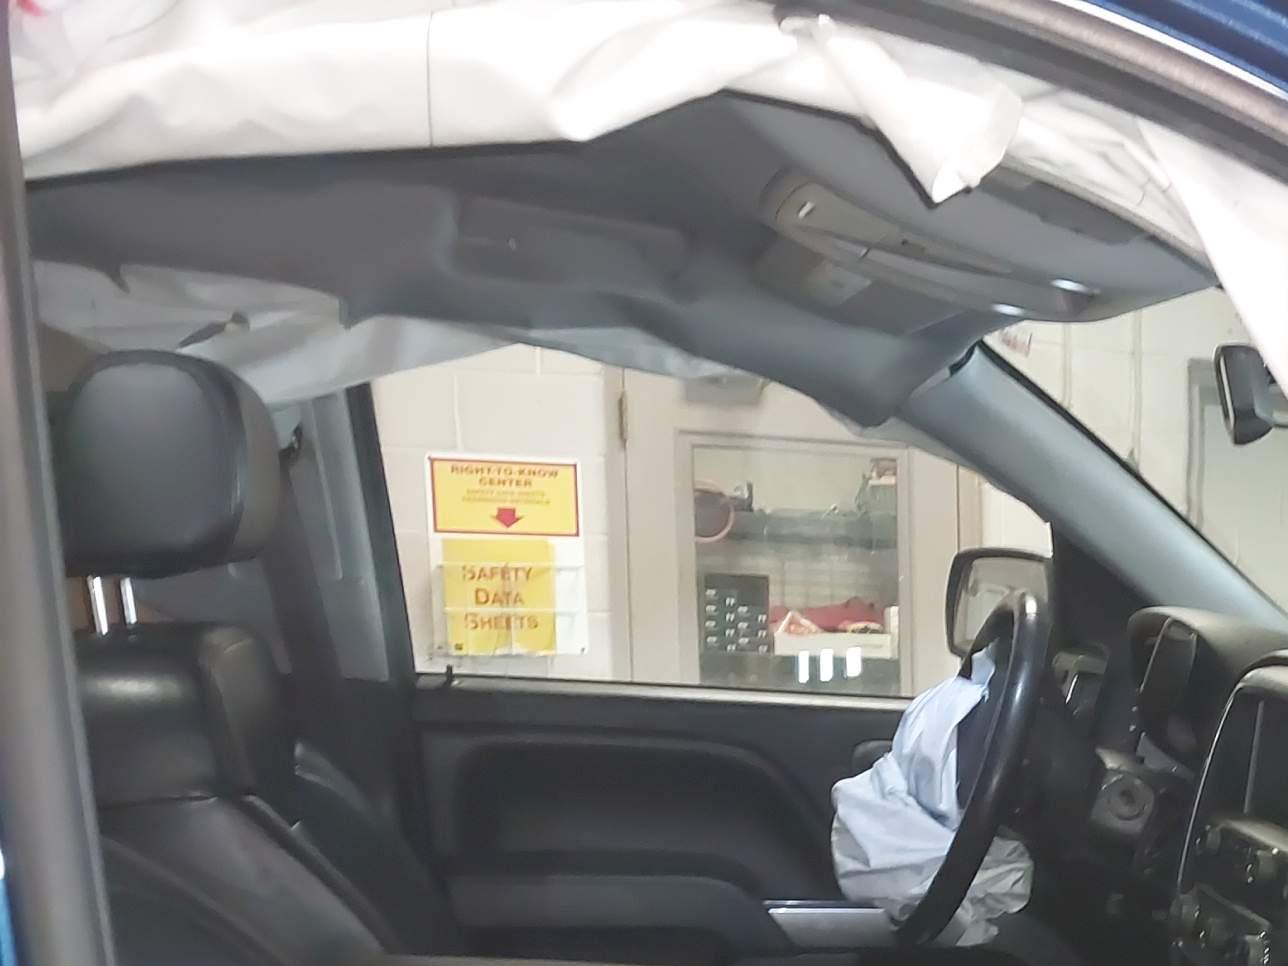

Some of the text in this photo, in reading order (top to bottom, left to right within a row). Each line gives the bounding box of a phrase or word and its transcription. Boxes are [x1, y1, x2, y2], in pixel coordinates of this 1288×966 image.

[478, 476, 533, 487] CENTER
[461, 564, 533, 581] SAFETY
[474, 586, 525, 606] DATA
